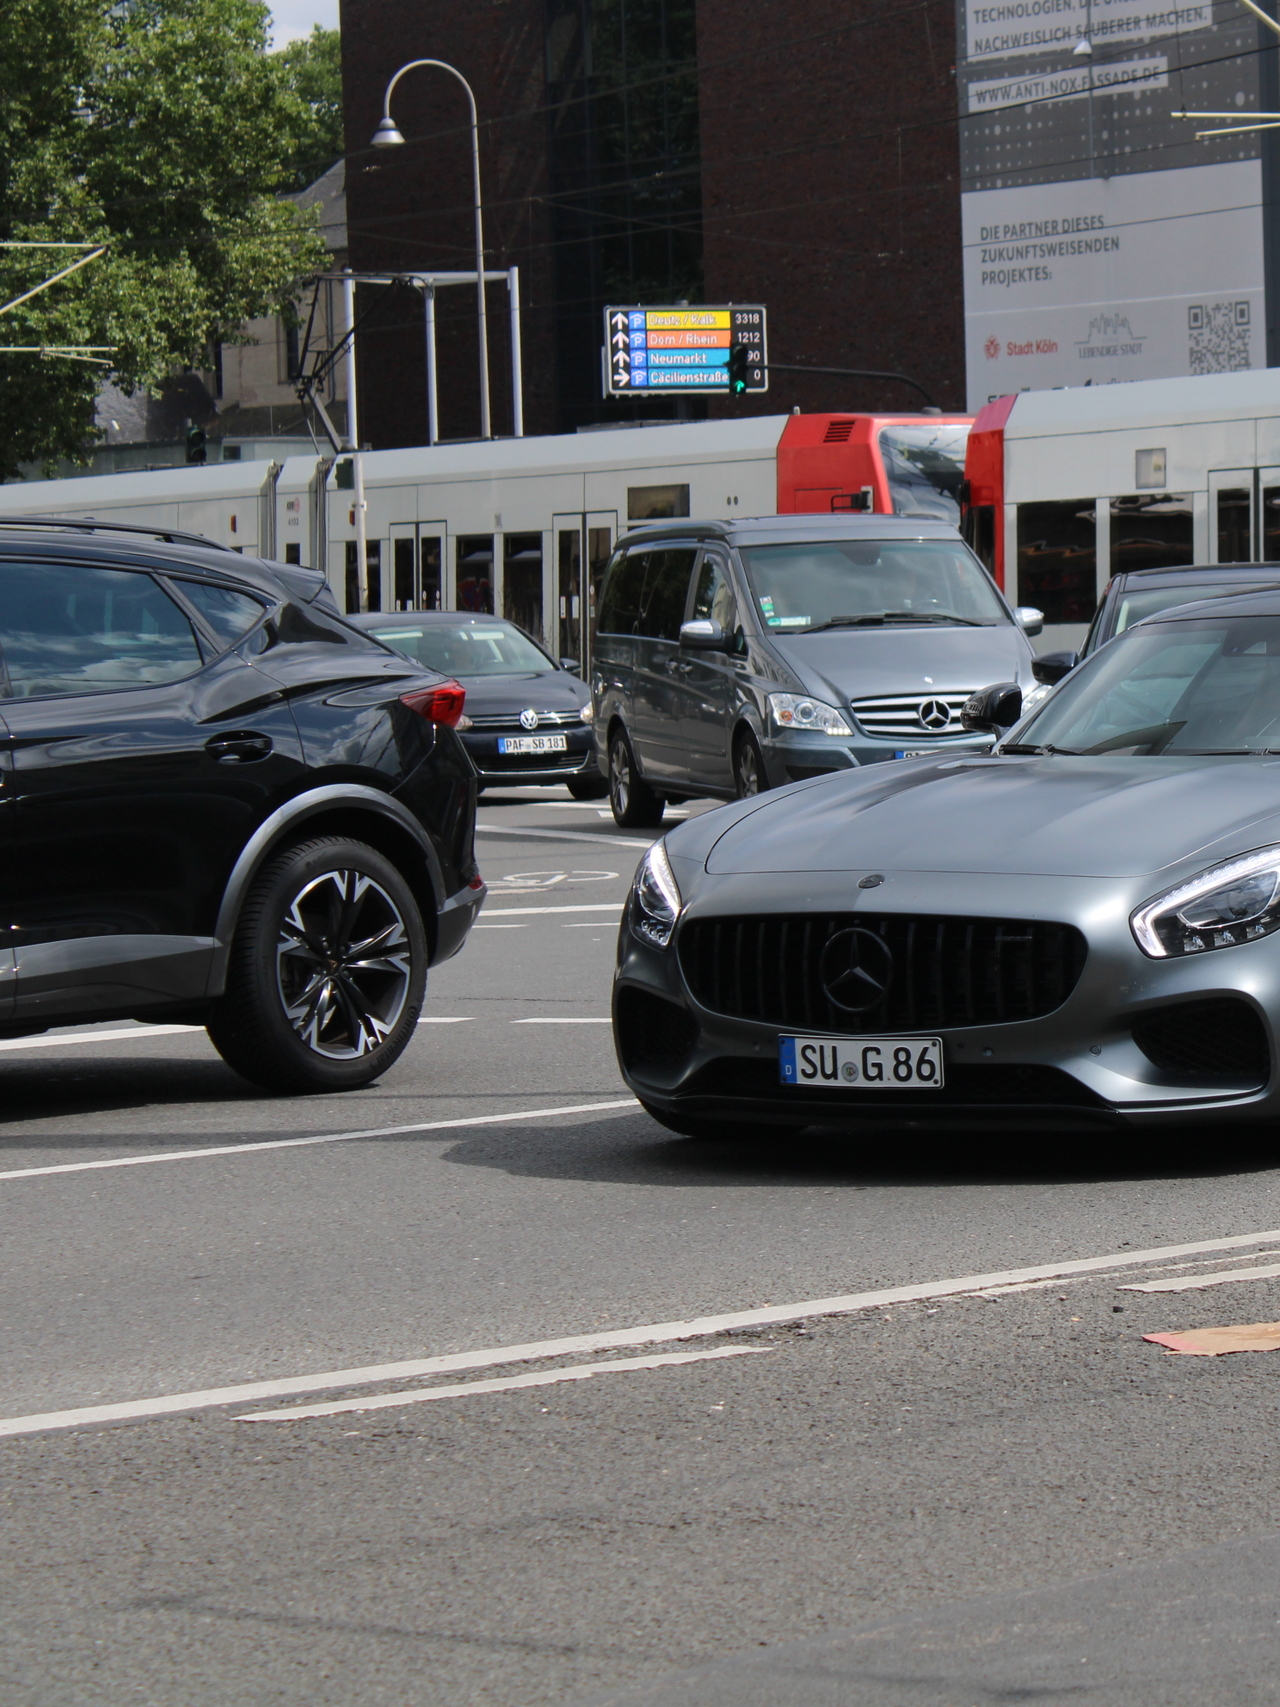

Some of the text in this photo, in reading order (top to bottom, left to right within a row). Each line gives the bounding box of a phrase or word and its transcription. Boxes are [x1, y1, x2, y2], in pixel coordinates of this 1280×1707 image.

[974, 0, 1077, 24] TECHNOLOGIEN,
[974, 7, 1208, 53] NACHWEISLICH SAUBERER MACHEN.
[975, 66, 1161, 104] WWW.ANTI-NOX-FASSADE.DE
[980, 215, 1105, 241] DIE PARTNER DIESES
[981, 236, 1120, 263] ZUKUNFTSWEISENDEN
[981, 266, 1052, 288] PROJEKTES:
[649, 313, 681, 326] Deutz
[690, 313, 717, 325] Kalk
[735, 313, 760, 324] 3318
[649, 334, 676, 345] Dom
[686, 333, 718, 344] Rhein
[737, 332, 761, 343] 1212
[1007, 339, 1058, 356] Stadt Köln
[650, 353, 708, 364] Neumarkt
[1079, 343, 1143, 359] LEBENDIGE STADT
[650, 370, 729, 384] Cäcilienstraße
[505, 737, 566, 751] PAF SB 181
[800, 1044, 839, 1080] SU
[861, 1046, 884, 1082] G
[892, 1046, 936, 1082] 86
